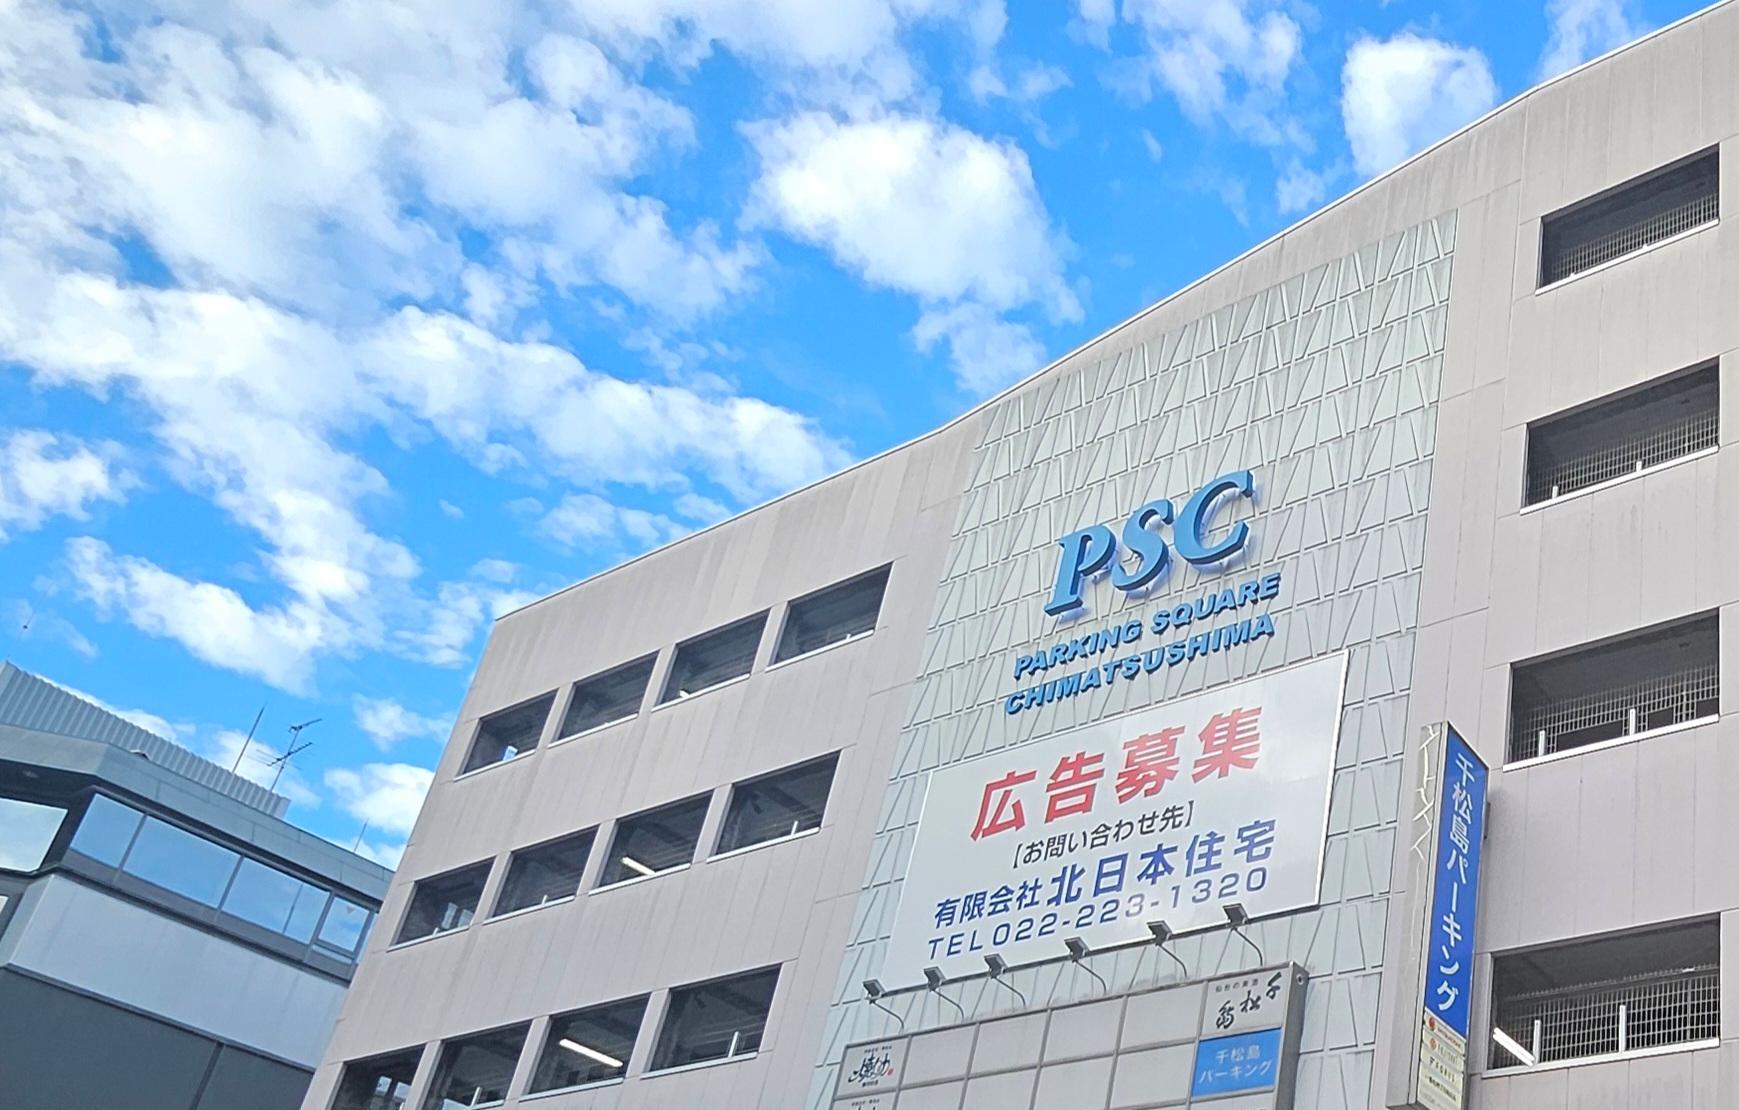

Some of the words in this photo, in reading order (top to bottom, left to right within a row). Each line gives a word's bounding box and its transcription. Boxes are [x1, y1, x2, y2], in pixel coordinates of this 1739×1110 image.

[1044, 469, 1254, 617] PSC
[1003, 612, 1276, 715] CHIMATSUSHIMA
[1013, 620, 1142, 680] PARKING
[1150, 573, 1282, 635] SQUARE
[970, 706, 1264, 842] 広告募集
[933, 818, 1277, 930] 有限会社北日本住宅
[1436, 751, 1475, 1012] 千松島パーキング
[1199, 1059, 1271, 1084] パーキング
[1215, 1046, 1262, 1066] 千松島
